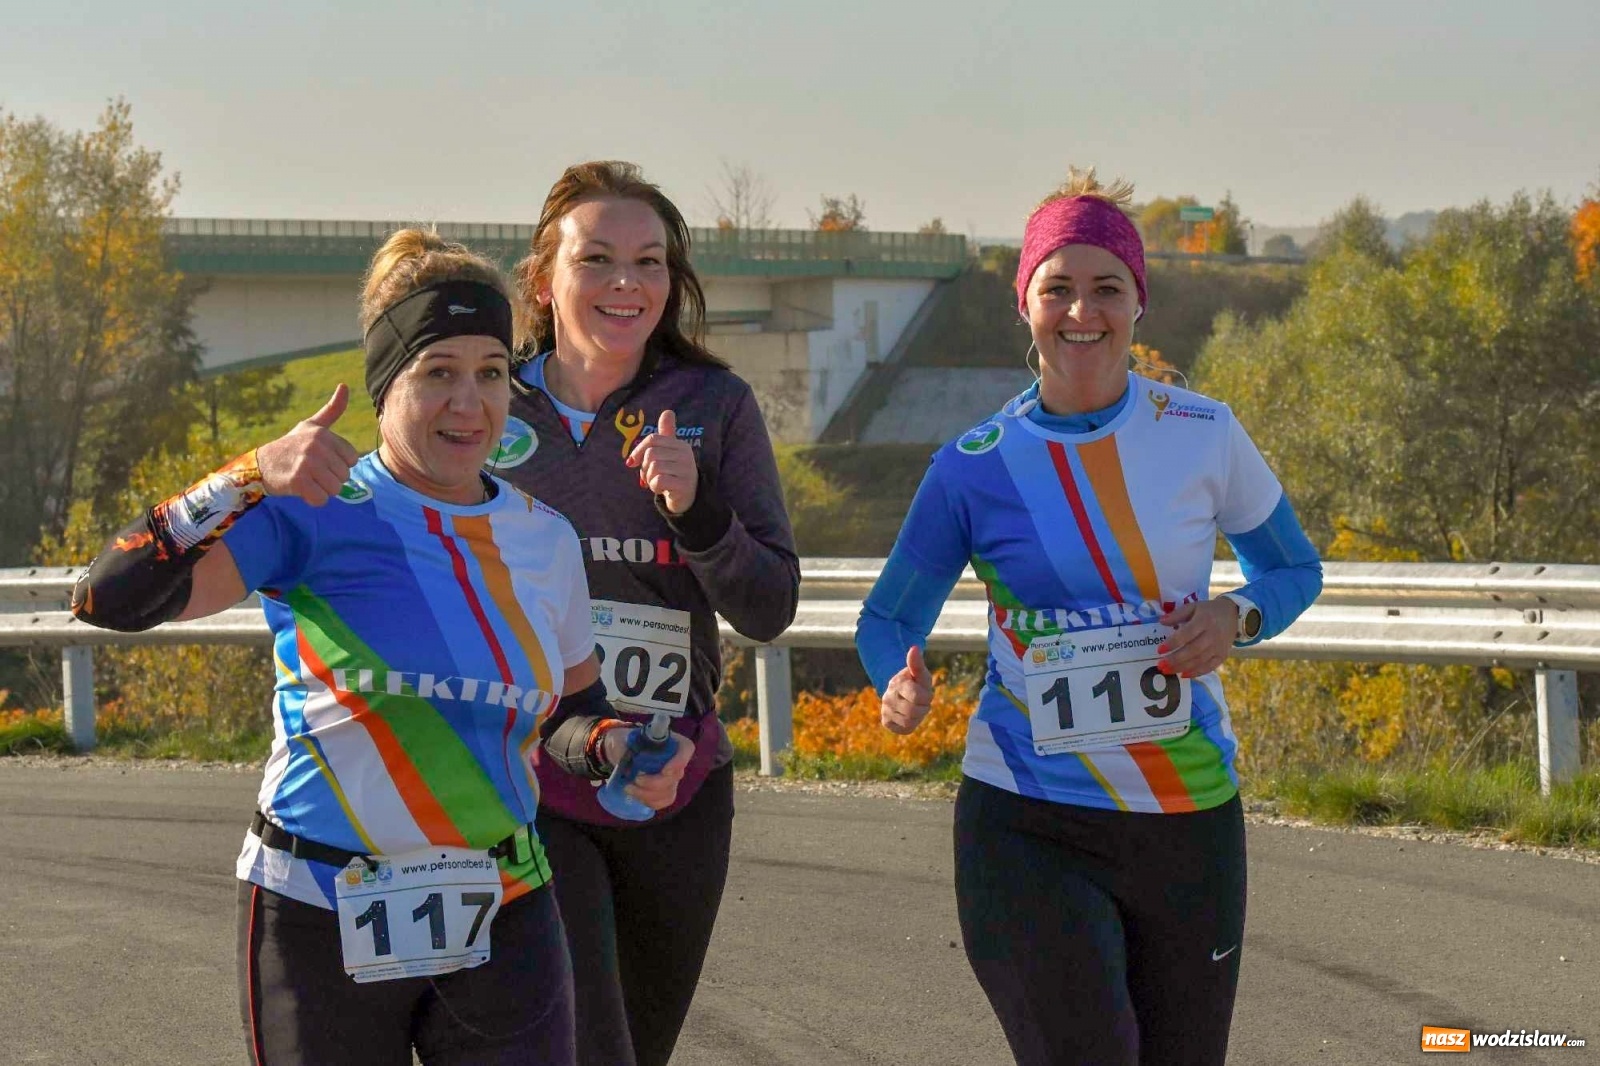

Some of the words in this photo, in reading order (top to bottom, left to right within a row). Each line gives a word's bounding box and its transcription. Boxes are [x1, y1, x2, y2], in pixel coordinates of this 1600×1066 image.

[619, 617, 690, 634] www.personalbest
[332, 668, 559, 716] ELEKTRO
[1041, 665, 1181, 730] 119
[401, 859, 492, 874] www.personalbest.pl
[355, 892, 495, 956] 117
